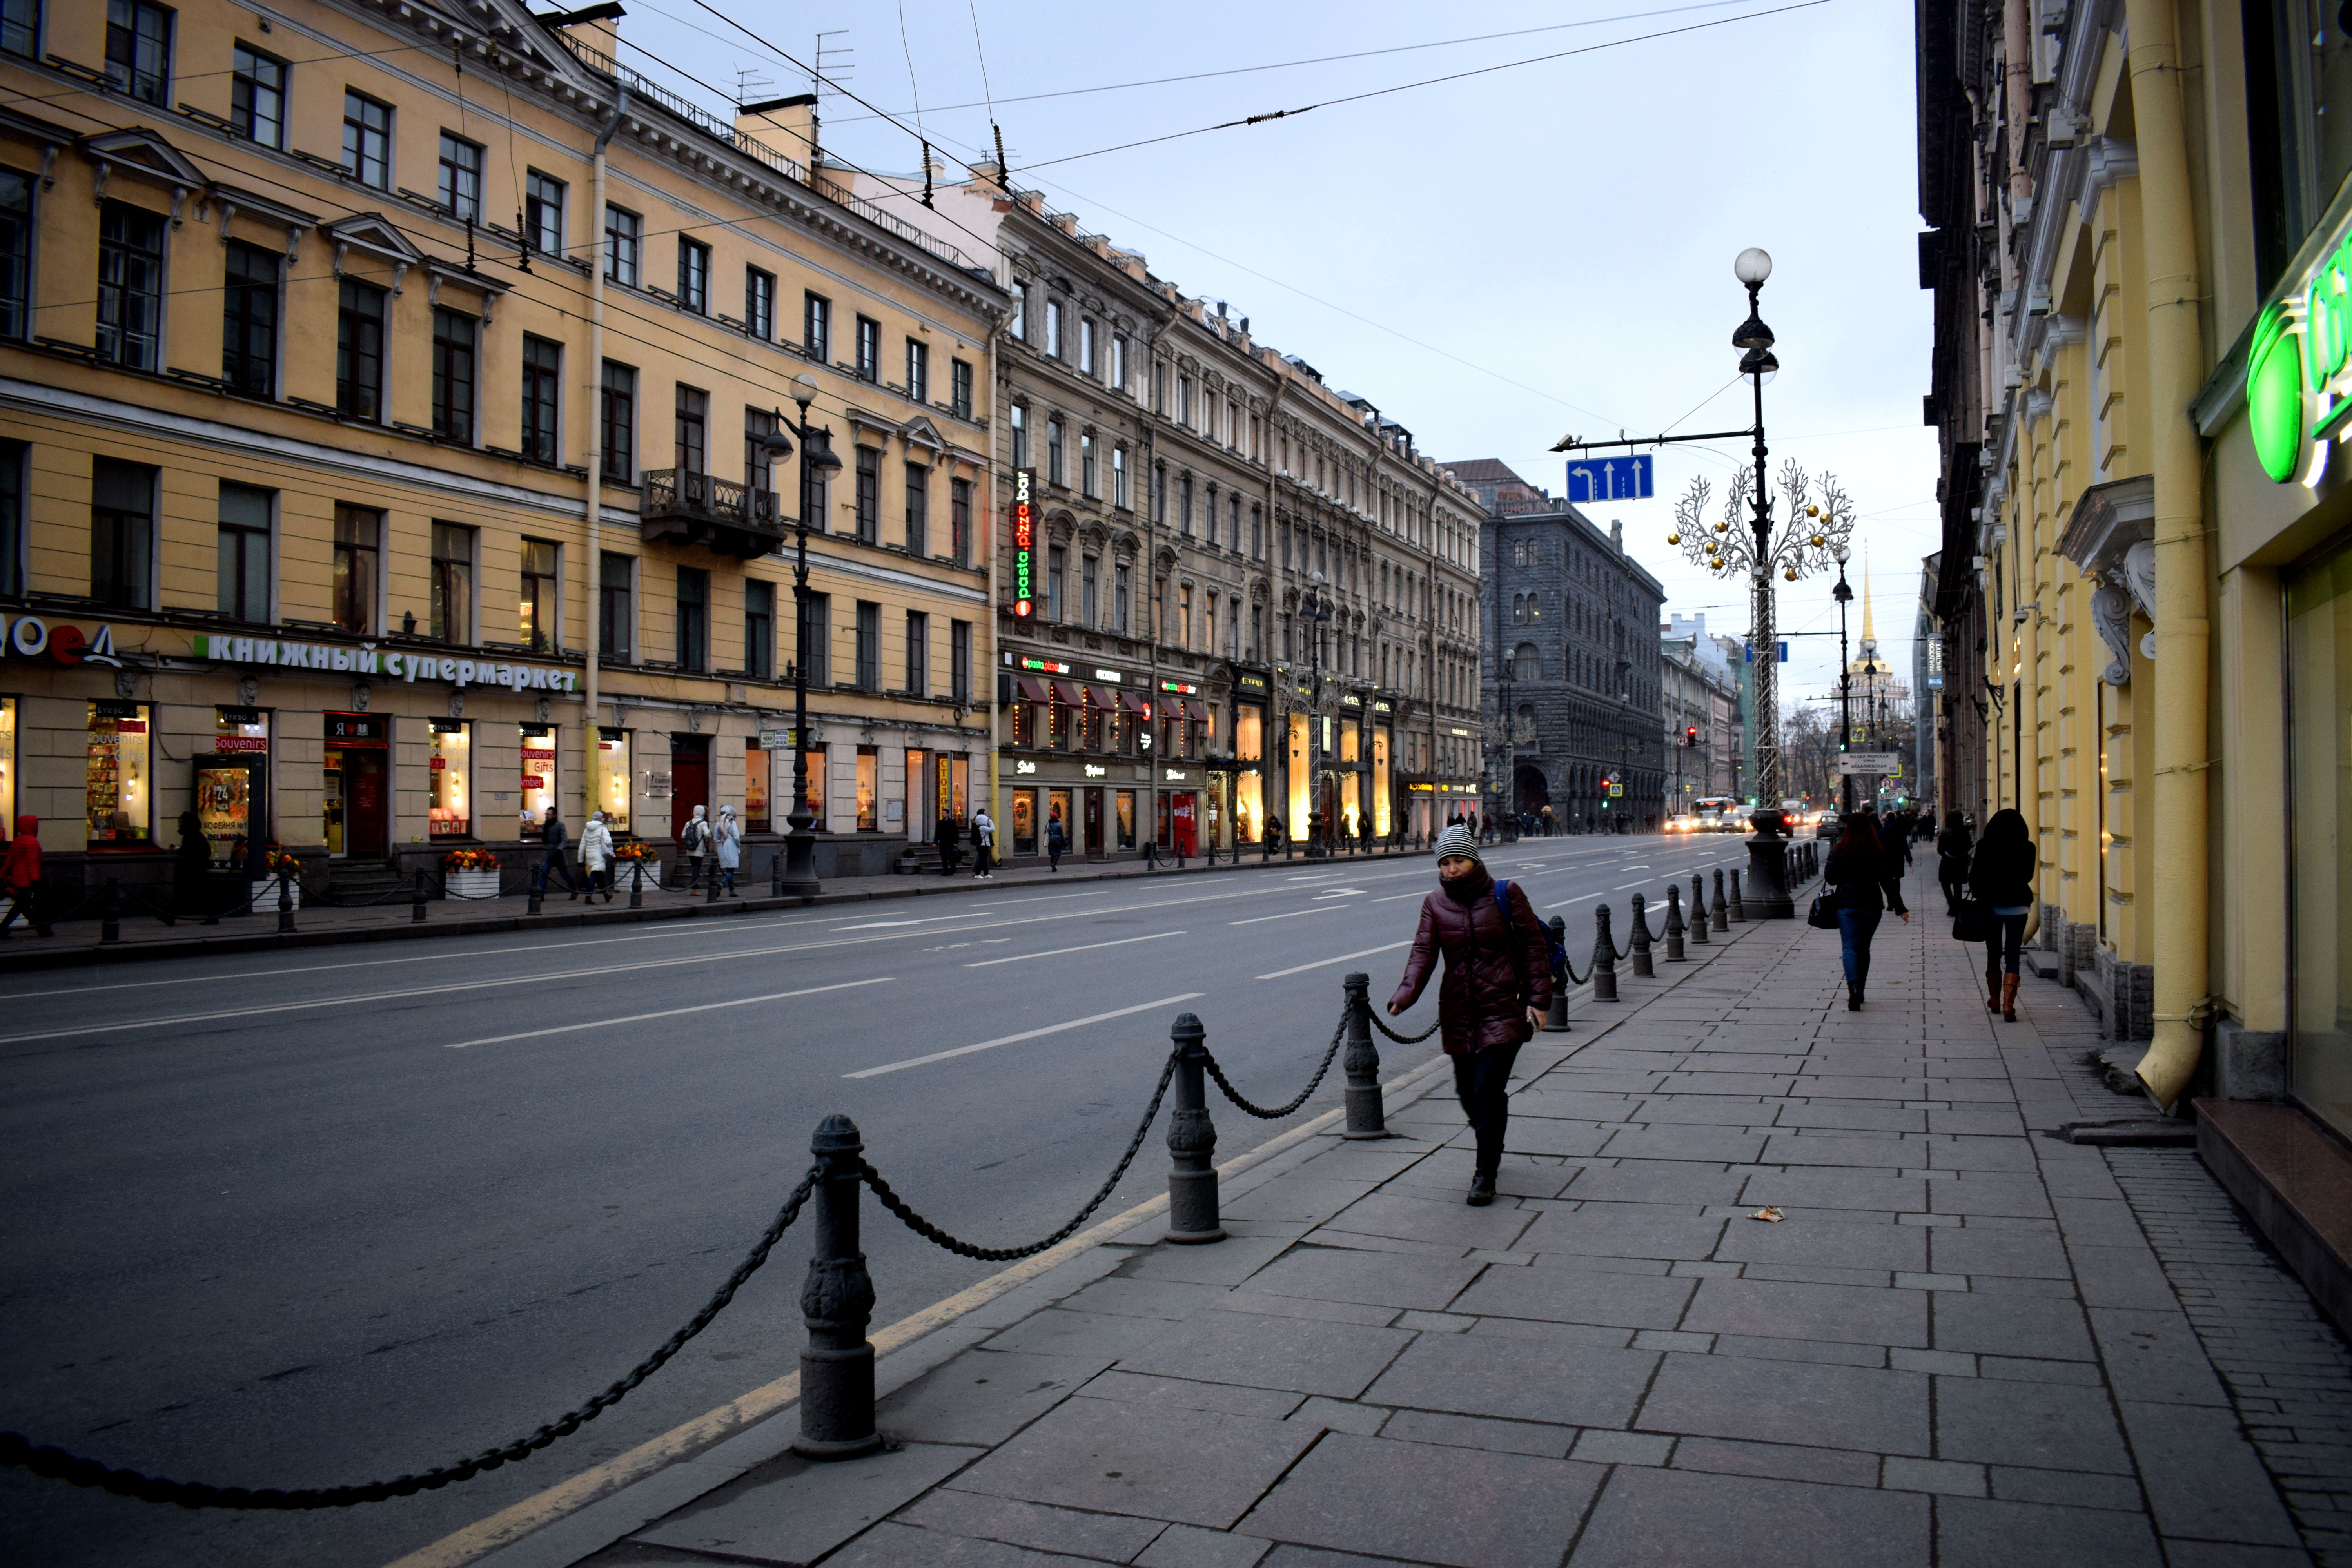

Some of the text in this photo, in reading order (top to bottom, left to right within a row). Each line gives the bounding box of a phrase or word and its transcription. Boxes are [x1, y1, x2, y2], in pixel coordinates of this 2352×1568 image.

[383, 653, 577, 692] супермаркет
[1242, 677, 1263, 687] ETRO
[1298, 687, 1311, 695] TRO
[335, 722, 345, 735] Я
[89, 733, 144, 745] ouvenirs
[216, 737, 266, 750] Souvenirs
[534, 762, 554, 772] Gifts
[217, 786, 228, 800] 24
